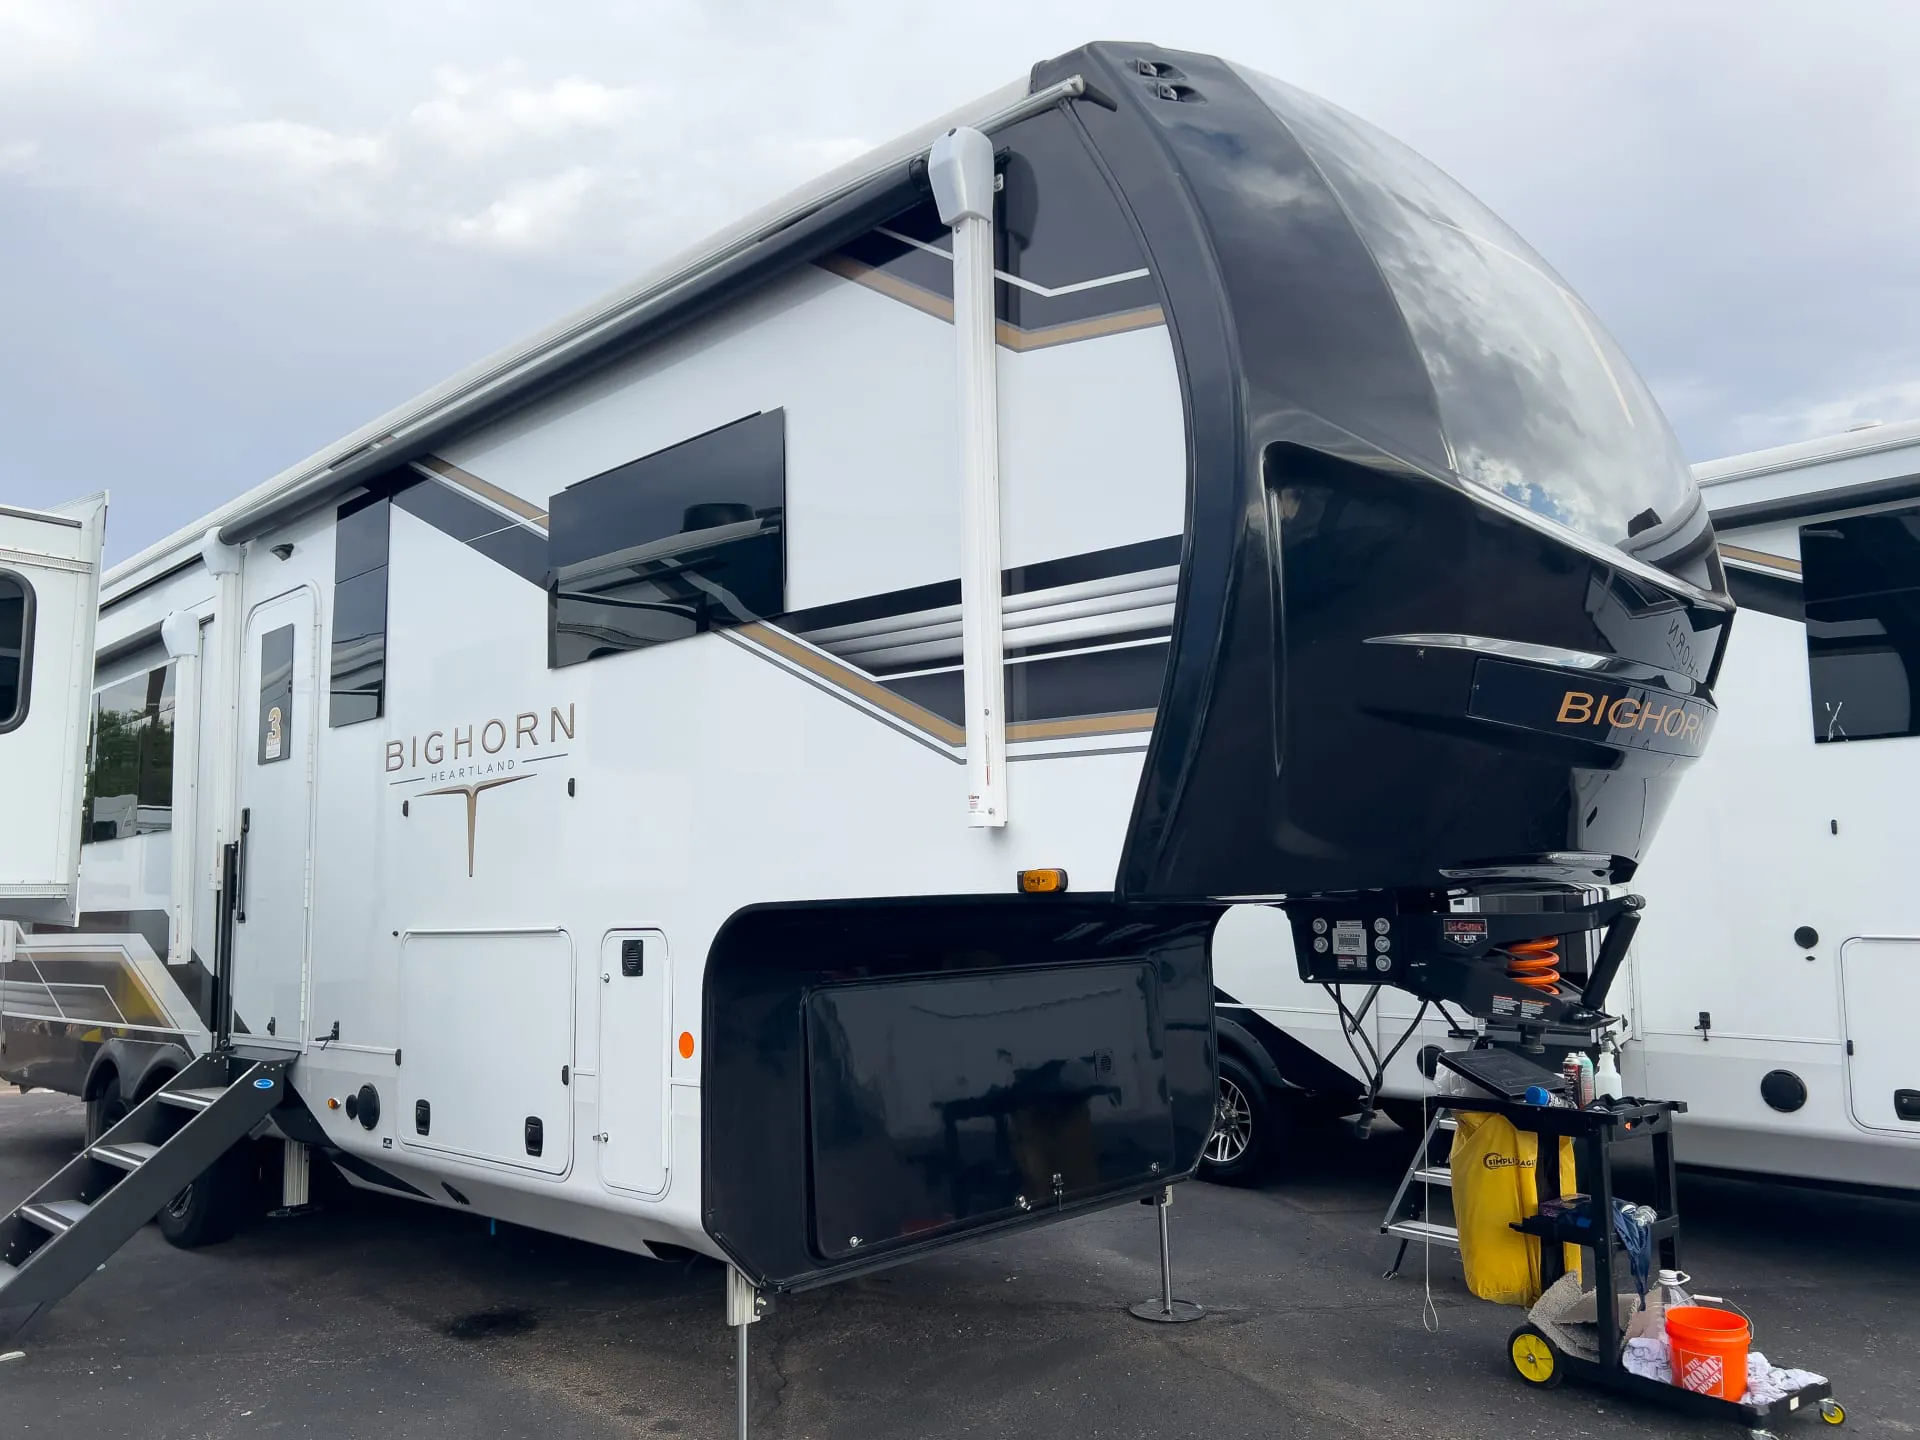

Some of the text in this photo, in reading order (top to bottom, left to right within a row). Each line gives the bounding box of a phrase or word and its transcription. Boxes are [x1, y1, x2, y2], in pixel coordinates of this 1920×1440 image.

[267, 706, 282, 739] 3
[1556, 691, 1704, 747] BIGHORN
[385, 702, 576, 773] BIGHORN
[431, 759, 516, 782] HEARTLAND
[1683, 1357, 1722, 1391] HOME
[1685, 1357, 1701, 1372] THE
[1698, 1371, 1722, 1394] DEPOT
